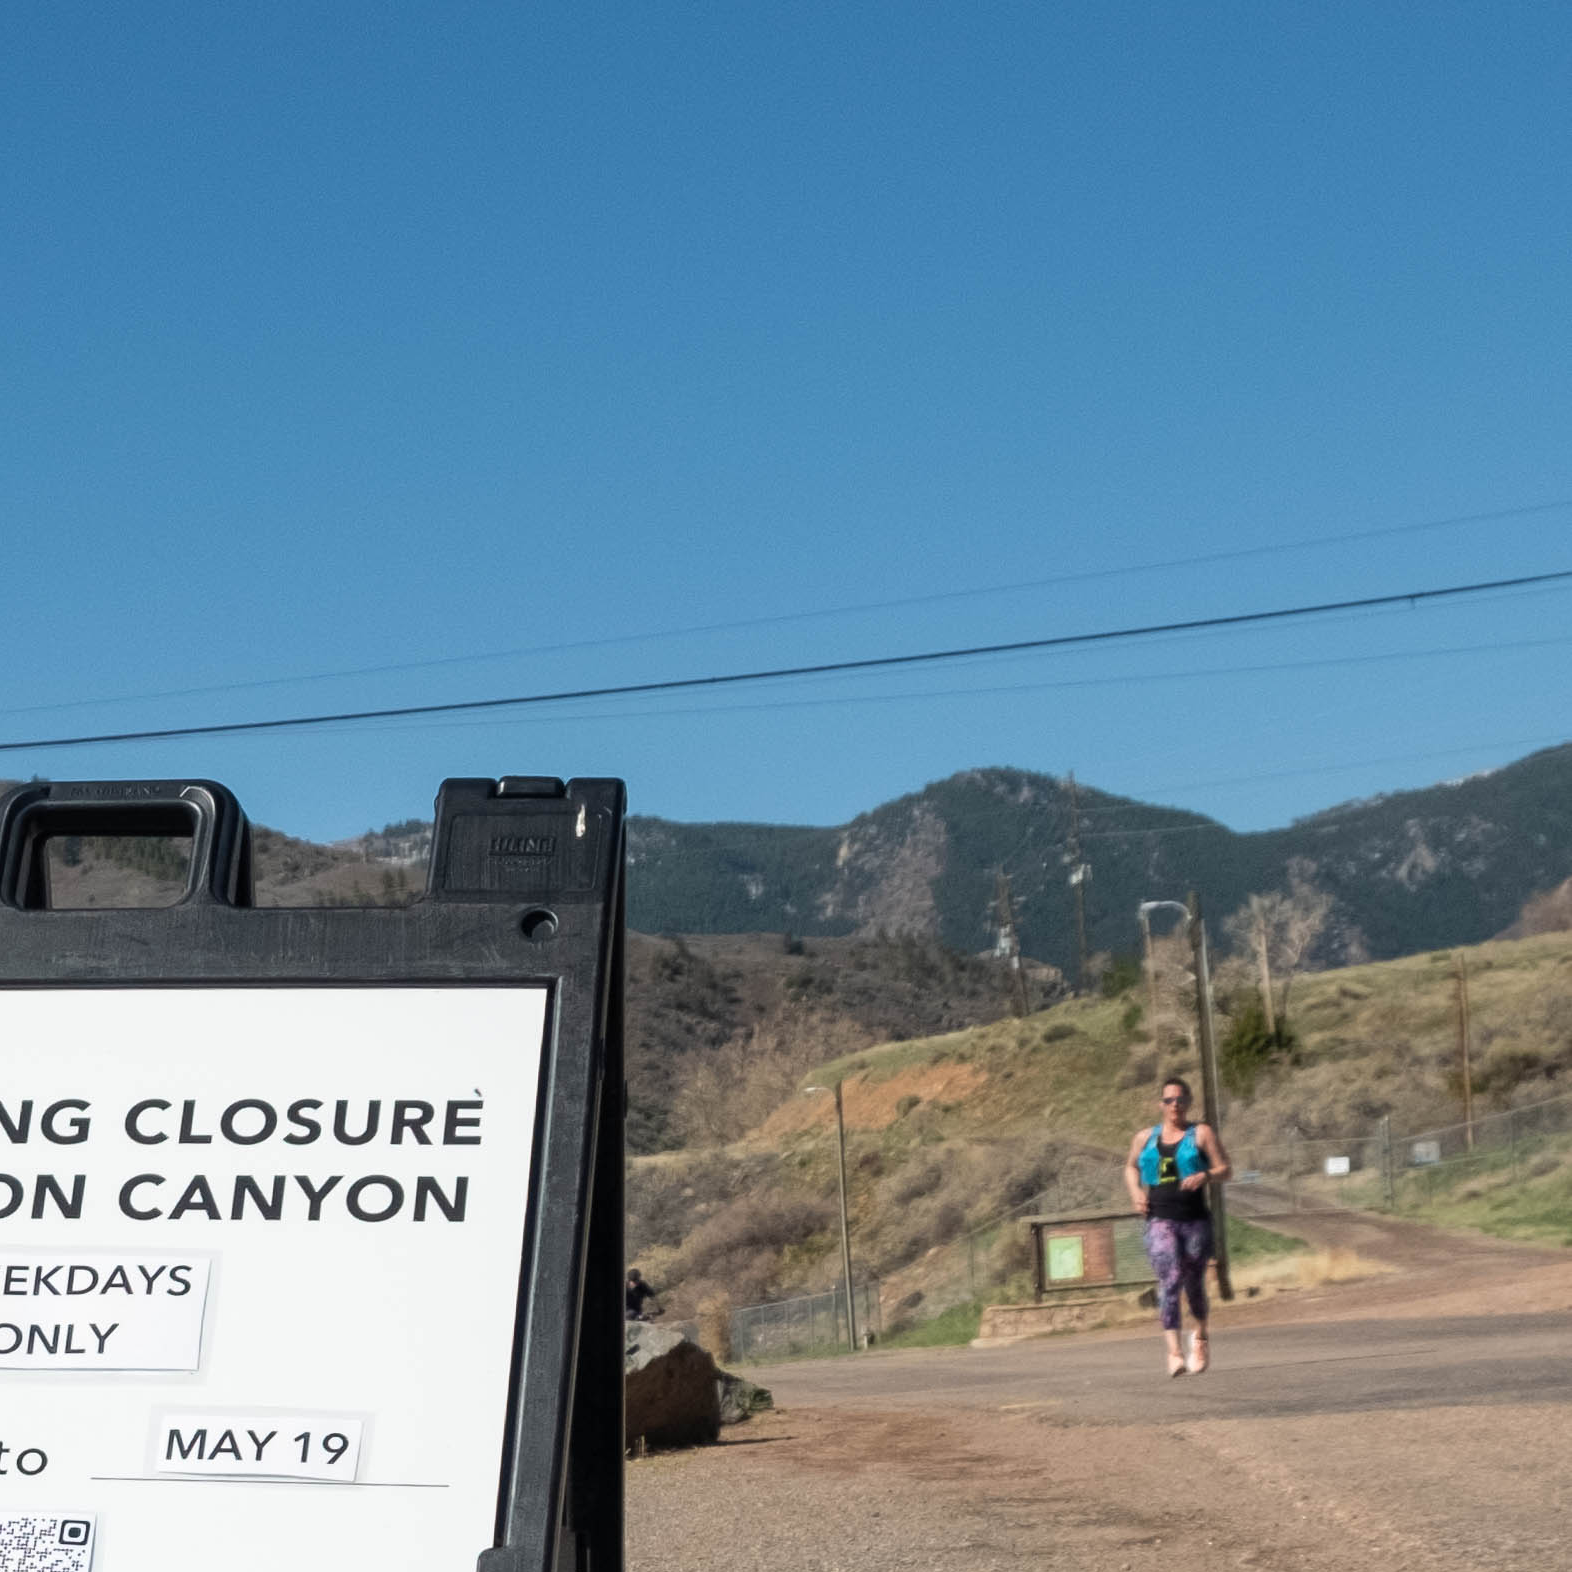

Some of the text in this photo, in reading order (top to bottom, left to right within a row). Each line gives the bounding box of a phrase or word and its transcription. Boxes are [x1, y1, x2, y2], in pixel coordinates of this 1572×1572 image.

[124, 1098, 484, 1146] CLOSURE
[118, 1173, 469, 1223] CANYON
[165, 1429, 278, 1462] MAY
[294, 1431, 349, 1465] 19
